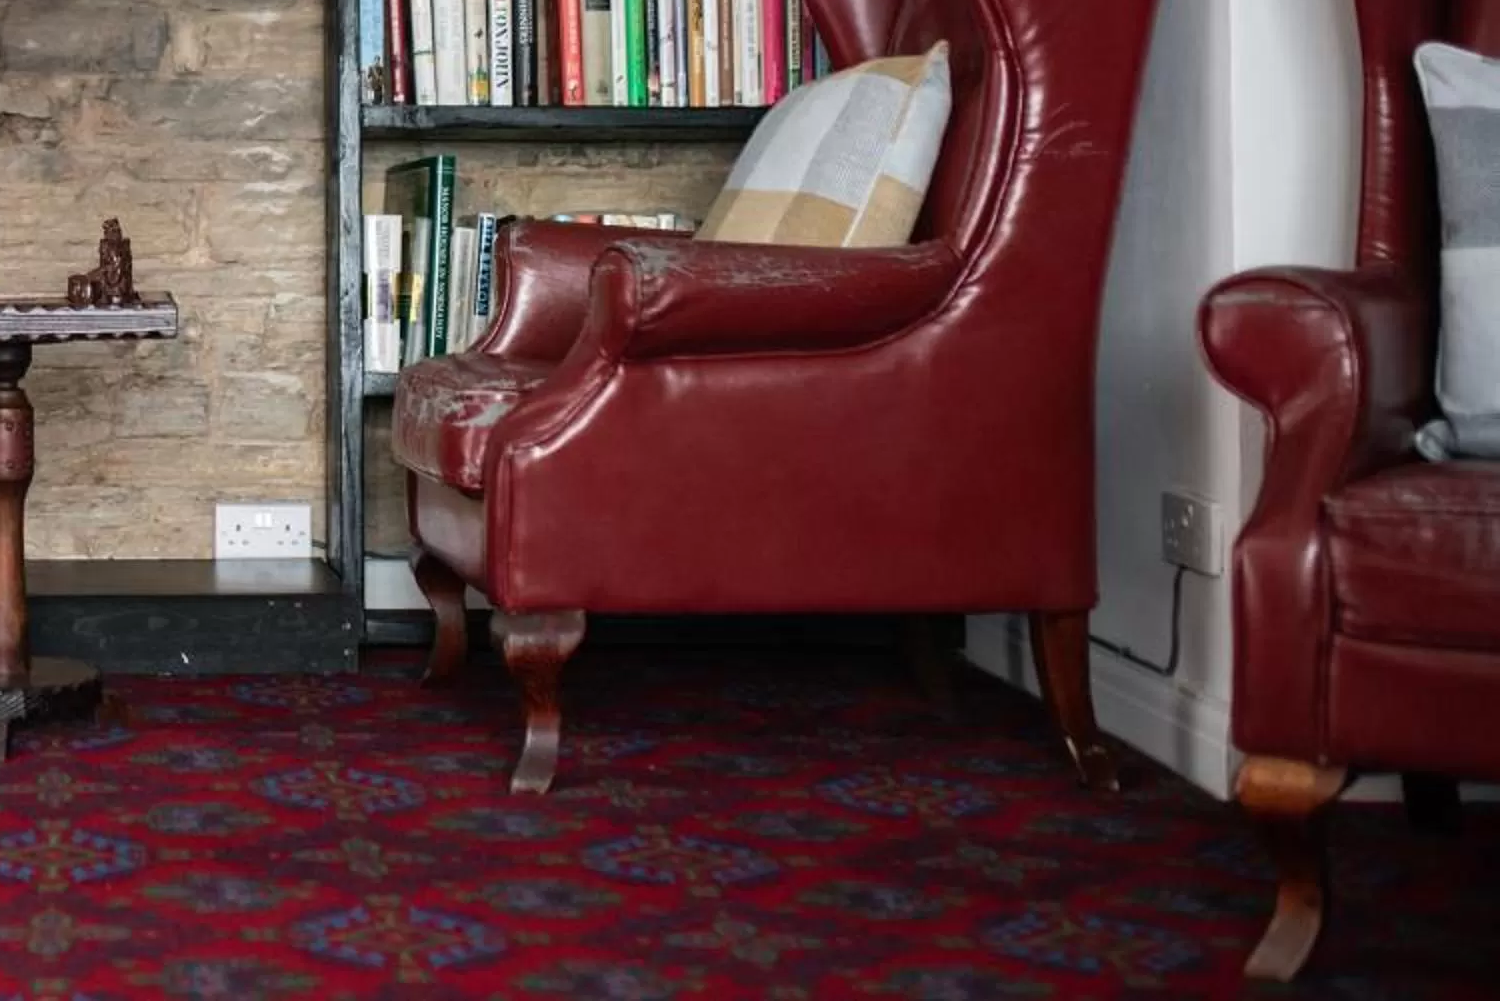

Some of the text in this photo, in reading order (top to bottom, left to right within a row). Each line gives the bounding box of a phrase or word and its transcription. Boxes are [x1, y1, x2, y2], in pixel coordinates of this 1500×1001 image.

[495, 41, 509, 88] JOHN
[441, 186, 449, 223] MANOR
[435, 282, 446, 340] NORMANDY
